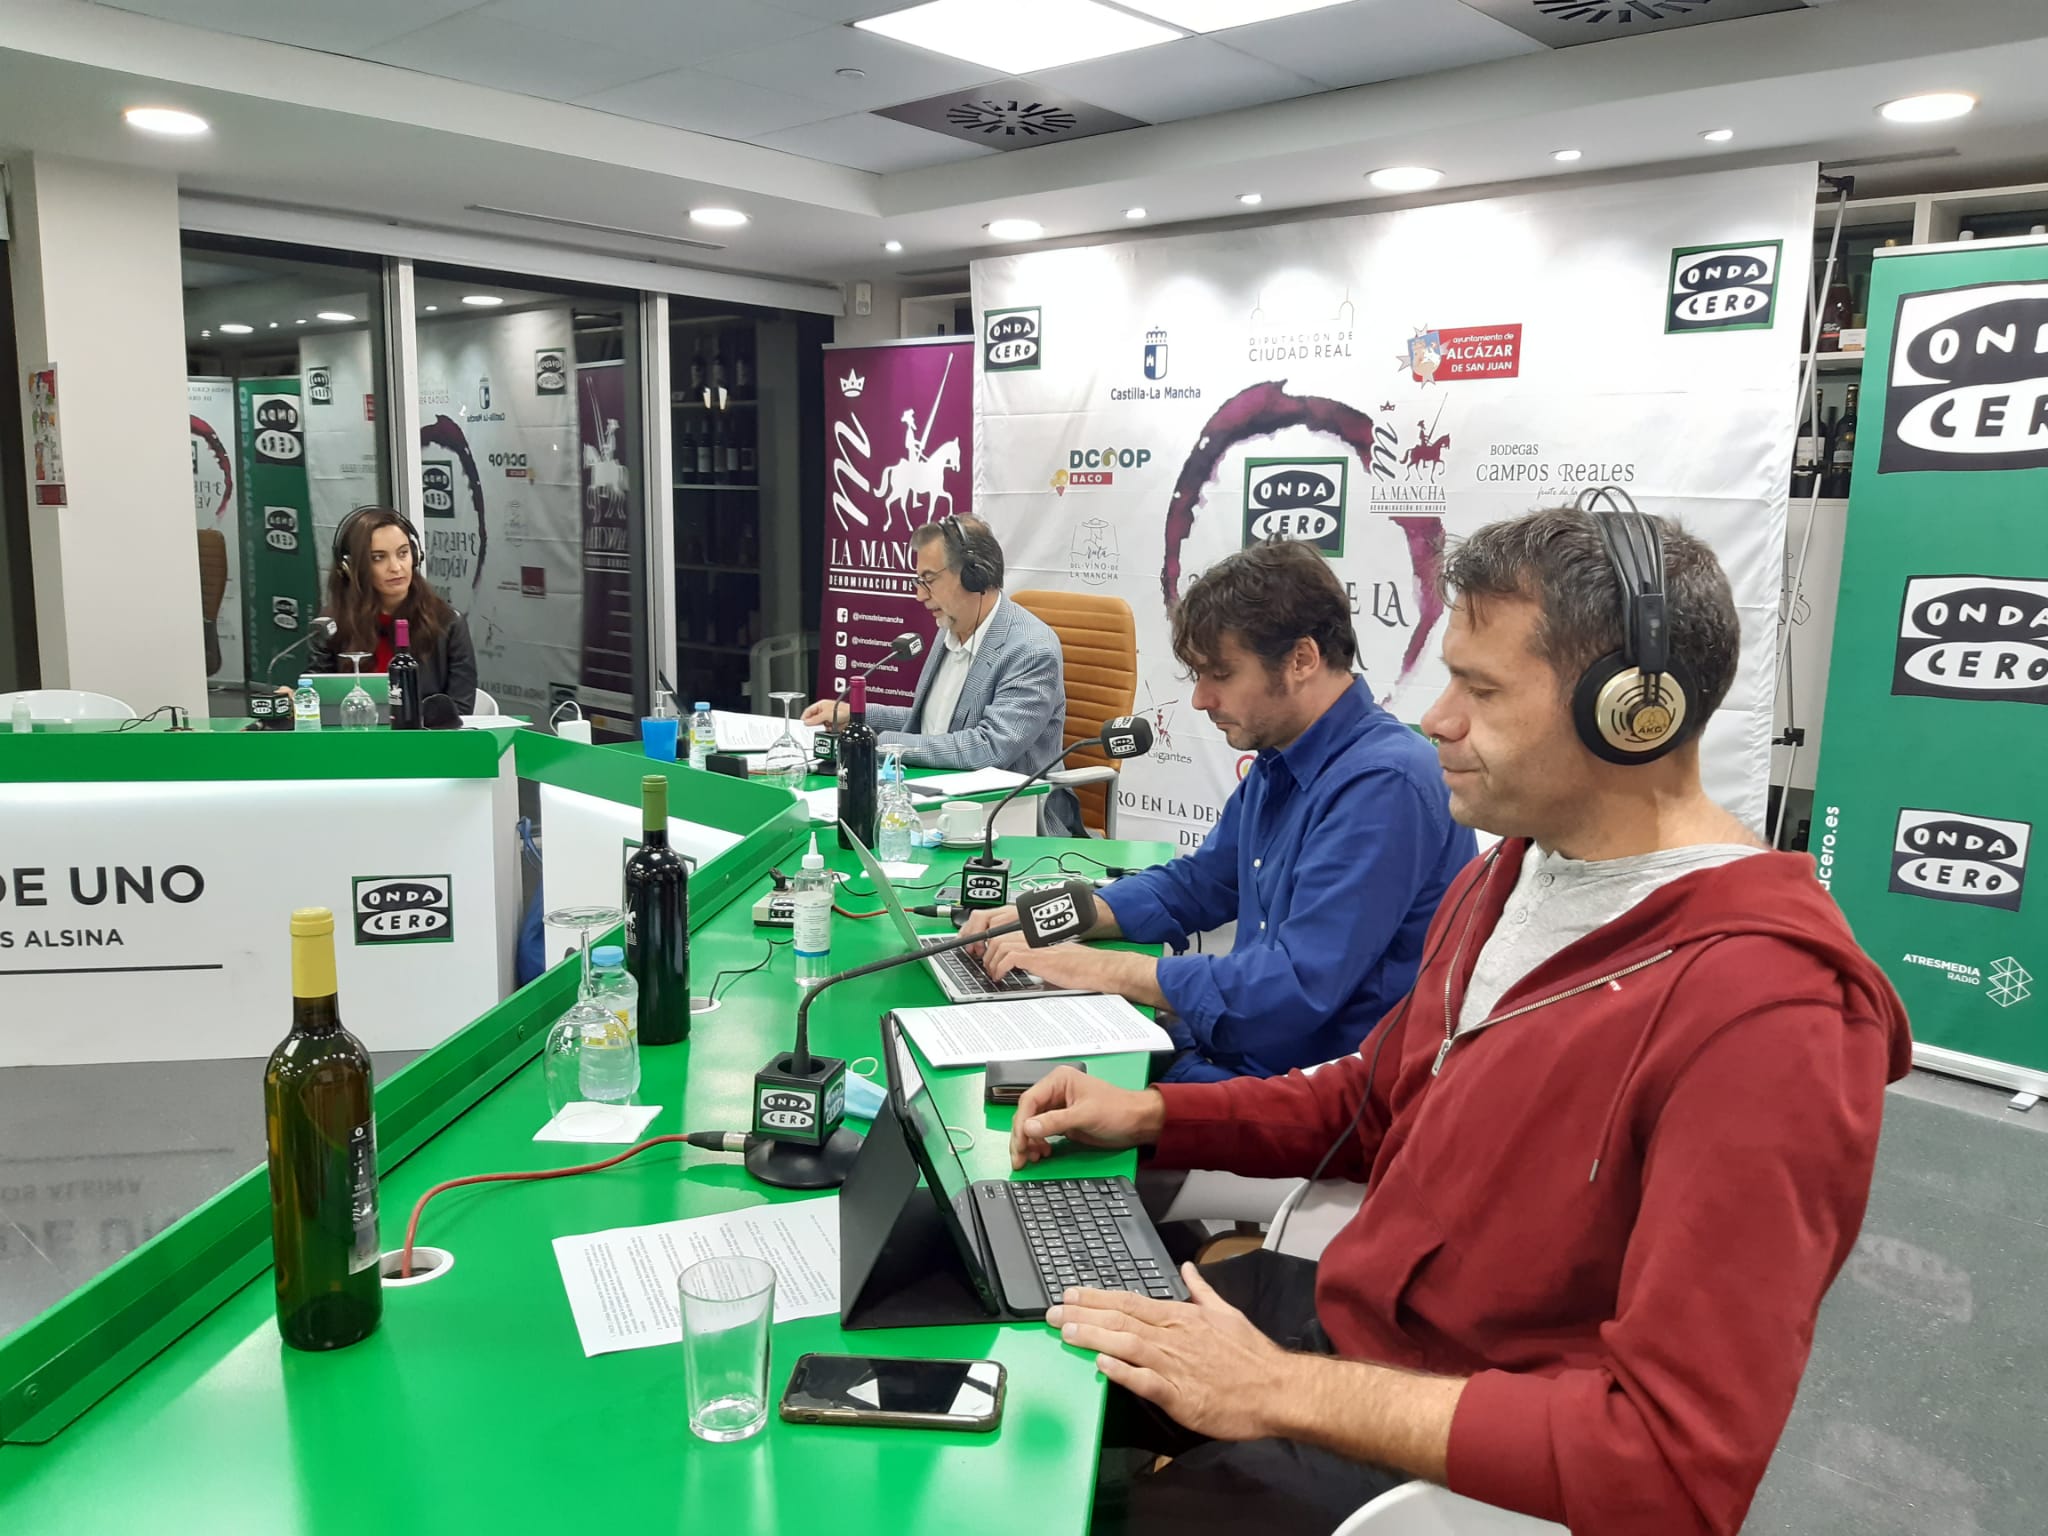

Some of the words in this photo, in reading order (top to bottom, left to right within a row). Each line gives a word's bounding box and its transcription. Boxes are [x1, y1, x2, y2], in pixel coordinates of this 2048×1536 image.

[1687, 263, 1760, 284] ONDA
[1688, 294, 1756, 315] CERO
[992, 322, 1032, 338] ONDA
[1249, 331, 1331, 346] DIPUTACIÓN
[1337, 330, 1353, 341] DE
[1452, 333, 1503, 344] ayuntamiento
[1503, 332, 1514, 340] de
[995, 344, 1031, 359] CERO
[1248, 343, 1309, 362] CIUDAD
[1314, 344, 1352, 358] REAL
[1446, 343, 1513, 360] ALCÁZAR
[1451, 363, 1463, 373] DE
[1465, 362, 1485, 372] SAN
[1486, 361, 1512, 371] JUAN
[1164, 386, 1201, 399] Mancha
[1072, 474, 1103, 483] BACO
[1260, 481, 1328, 500] ONDA
[1371, 485, 1386, 500] LA
[1391, 485, 1446, 500] MANCHA
[1263, 514, 1326, 535] CERO
[831, 538, 853, 566] LA
[860, 539, 917, 571] MANC
[829, 575, 897, 591] DENOMINACIÓN
[902, 579, 913, 592] DE
[1083, 571, 1119, 580] MANCHA
[1373, 581, 1410, 628] LA
[1926, 602, 2048, 629] ONDA
[1928, 649, 2048, 681] CERO
[1638, 726, 1663, 734] AKG
[1141, 795, 1161, 812] EN
[1168, 799, 1187, 818] LA
[1914, 827, 2006, 855] ONDA
[69, 864, 205, 906] UNO
[1914, 862, 2002, 891] CERO
[368, 890, 437, 905] ONDA
[1038, 901, 1066, 917] CERO
[373, 914, 437, 931] CERO
[1041, 912, 1073, 929] ONDA
[24, 928, 124, 948] ALSINA
[1902, 953, 1981, 977] ATRESMEDIA
[1946, 972, 1980, 986] RADIO
[767, 1097, 808, 1109] ONDA
[769, 1113, 806, 1125] CERO
